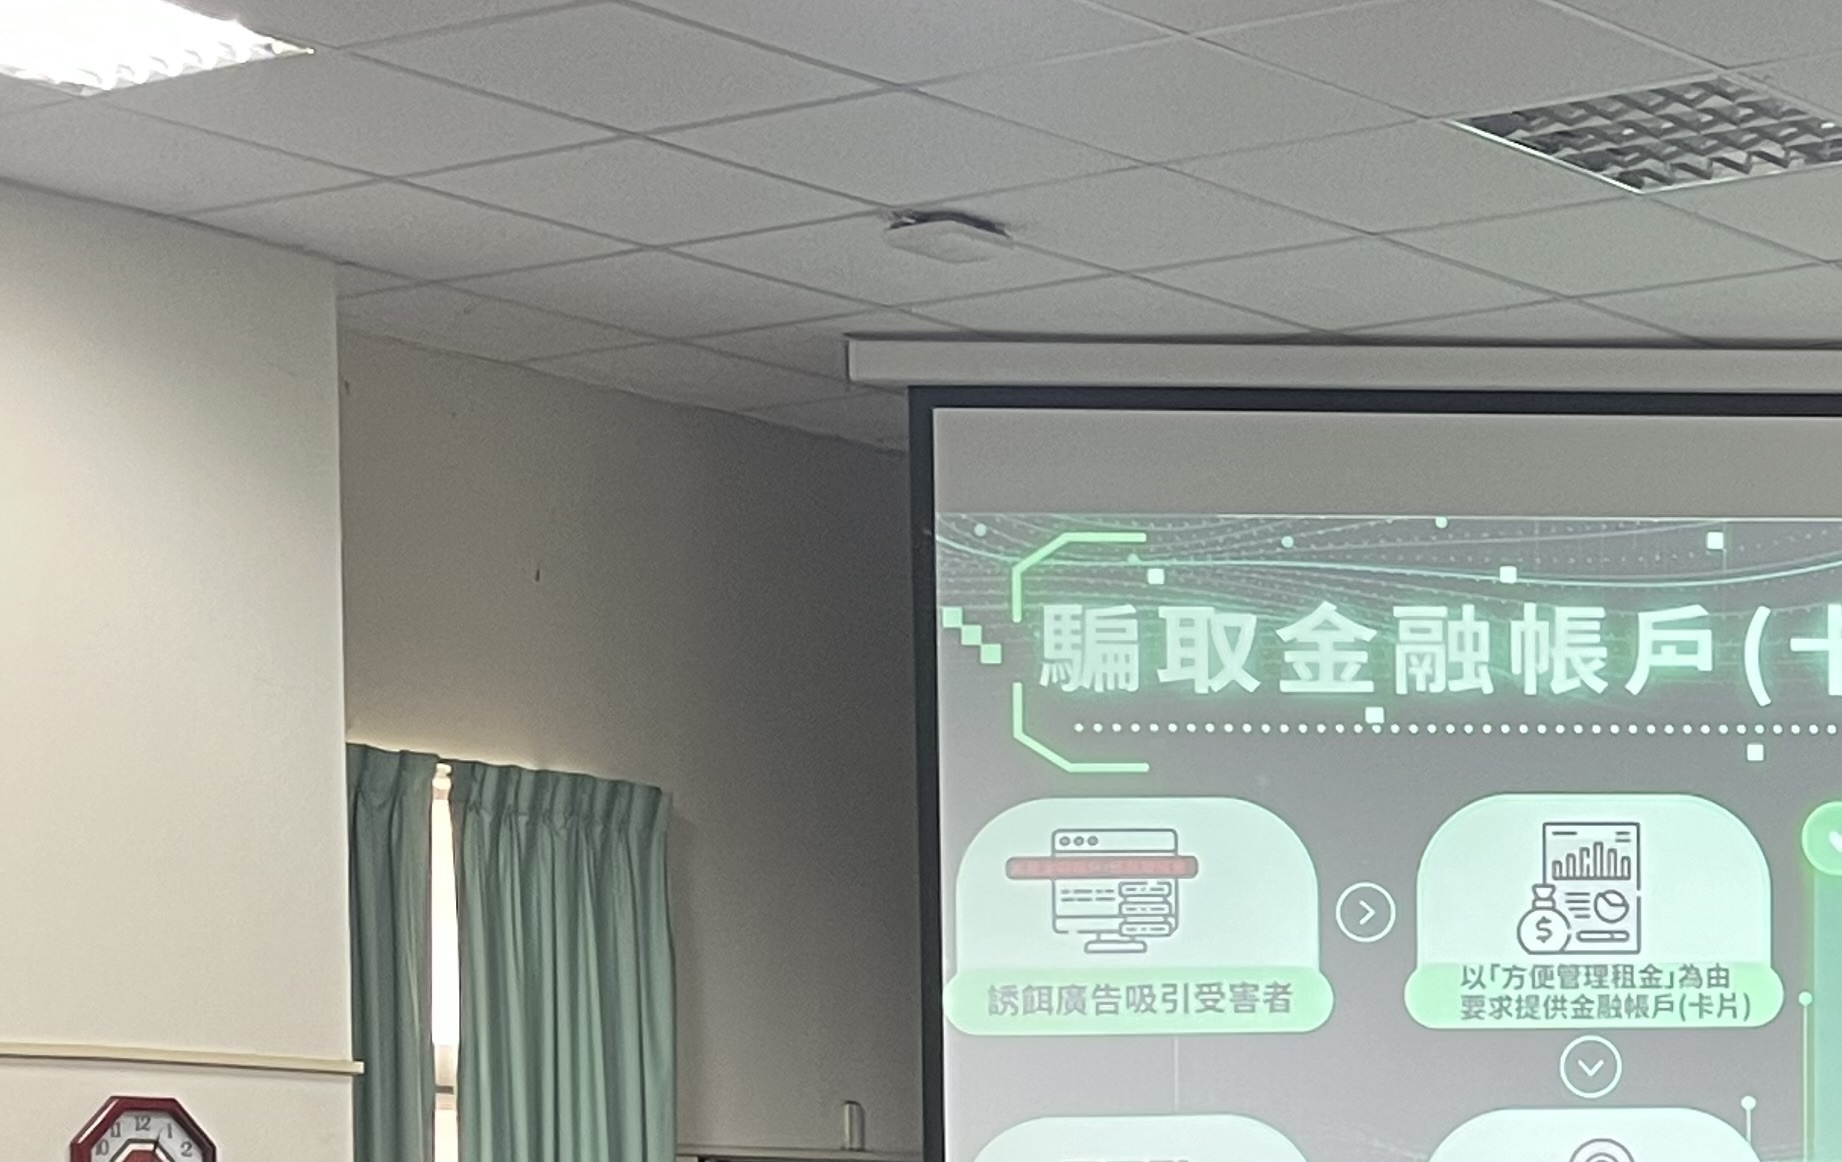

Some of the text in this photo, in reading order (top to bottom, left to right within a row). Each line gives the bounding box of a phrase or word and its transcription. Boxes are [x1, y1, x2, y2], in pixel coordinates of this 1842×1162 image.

[987, 981, 1294, 1017] 誘餌廣告吸引受害者
[1460, 992, 1752, 1022] 要求提供金融帳戶(卡片)
[134, 1116, 151, 1132] 12
[166, 1123, 173, 1139] 1
[180, 1142, 193, 1157] 2
